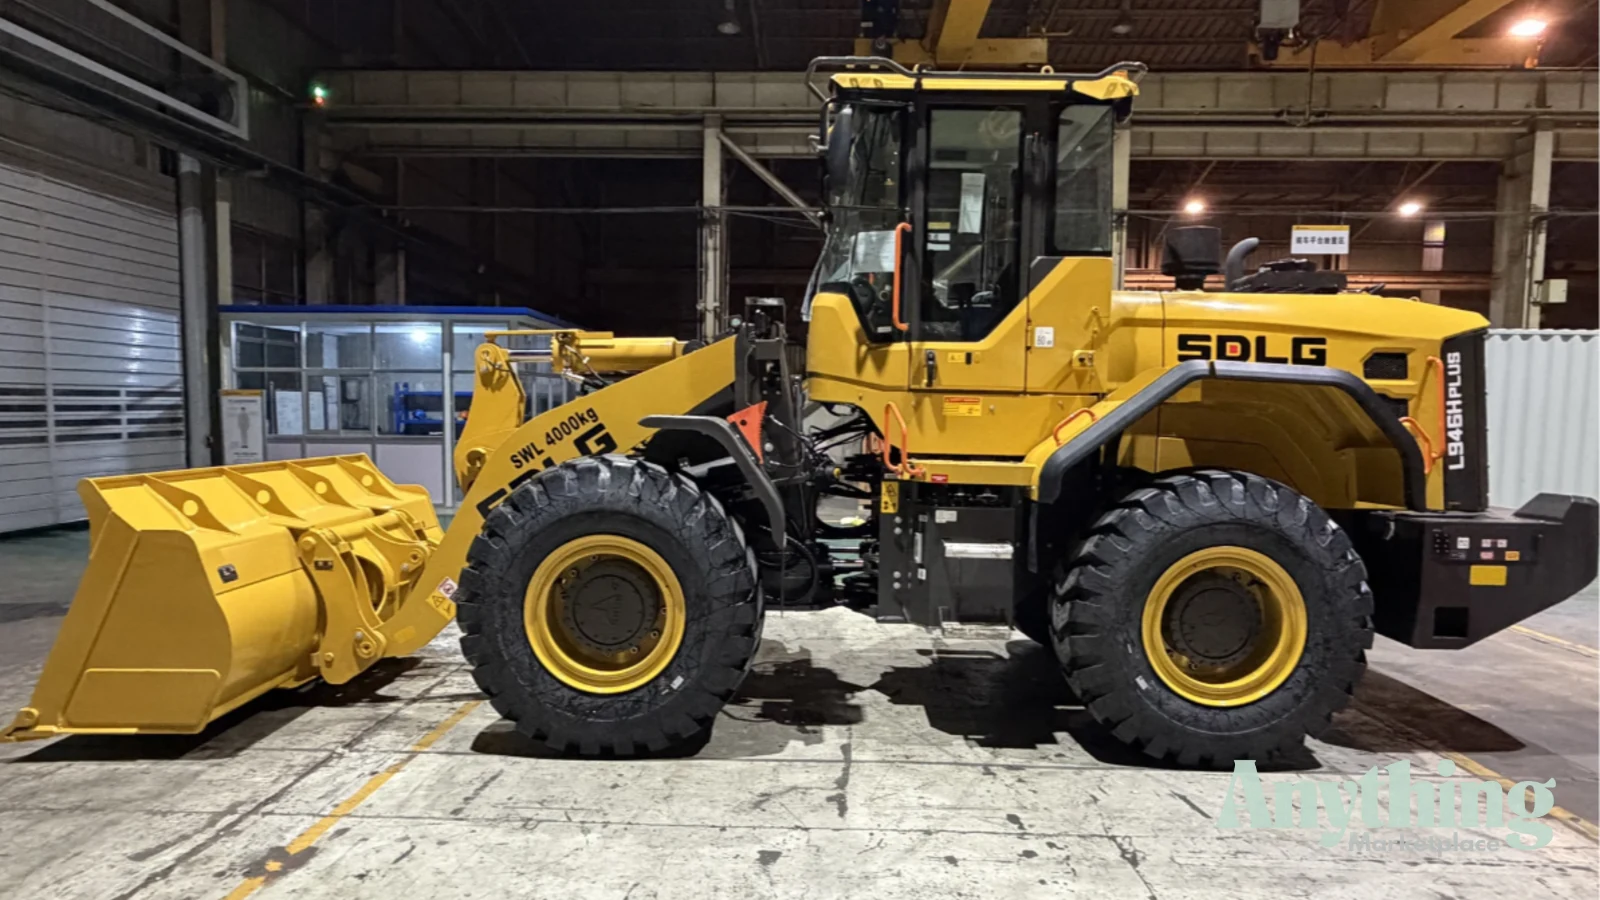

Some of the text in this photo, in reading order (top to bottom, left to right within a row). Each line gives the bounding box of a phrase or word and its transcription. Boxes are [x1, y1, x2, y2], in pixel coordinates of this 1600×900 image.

[1177, 333, 1327, 366] SDLG
[510, 407, 599, 469] SWL 4000kg
